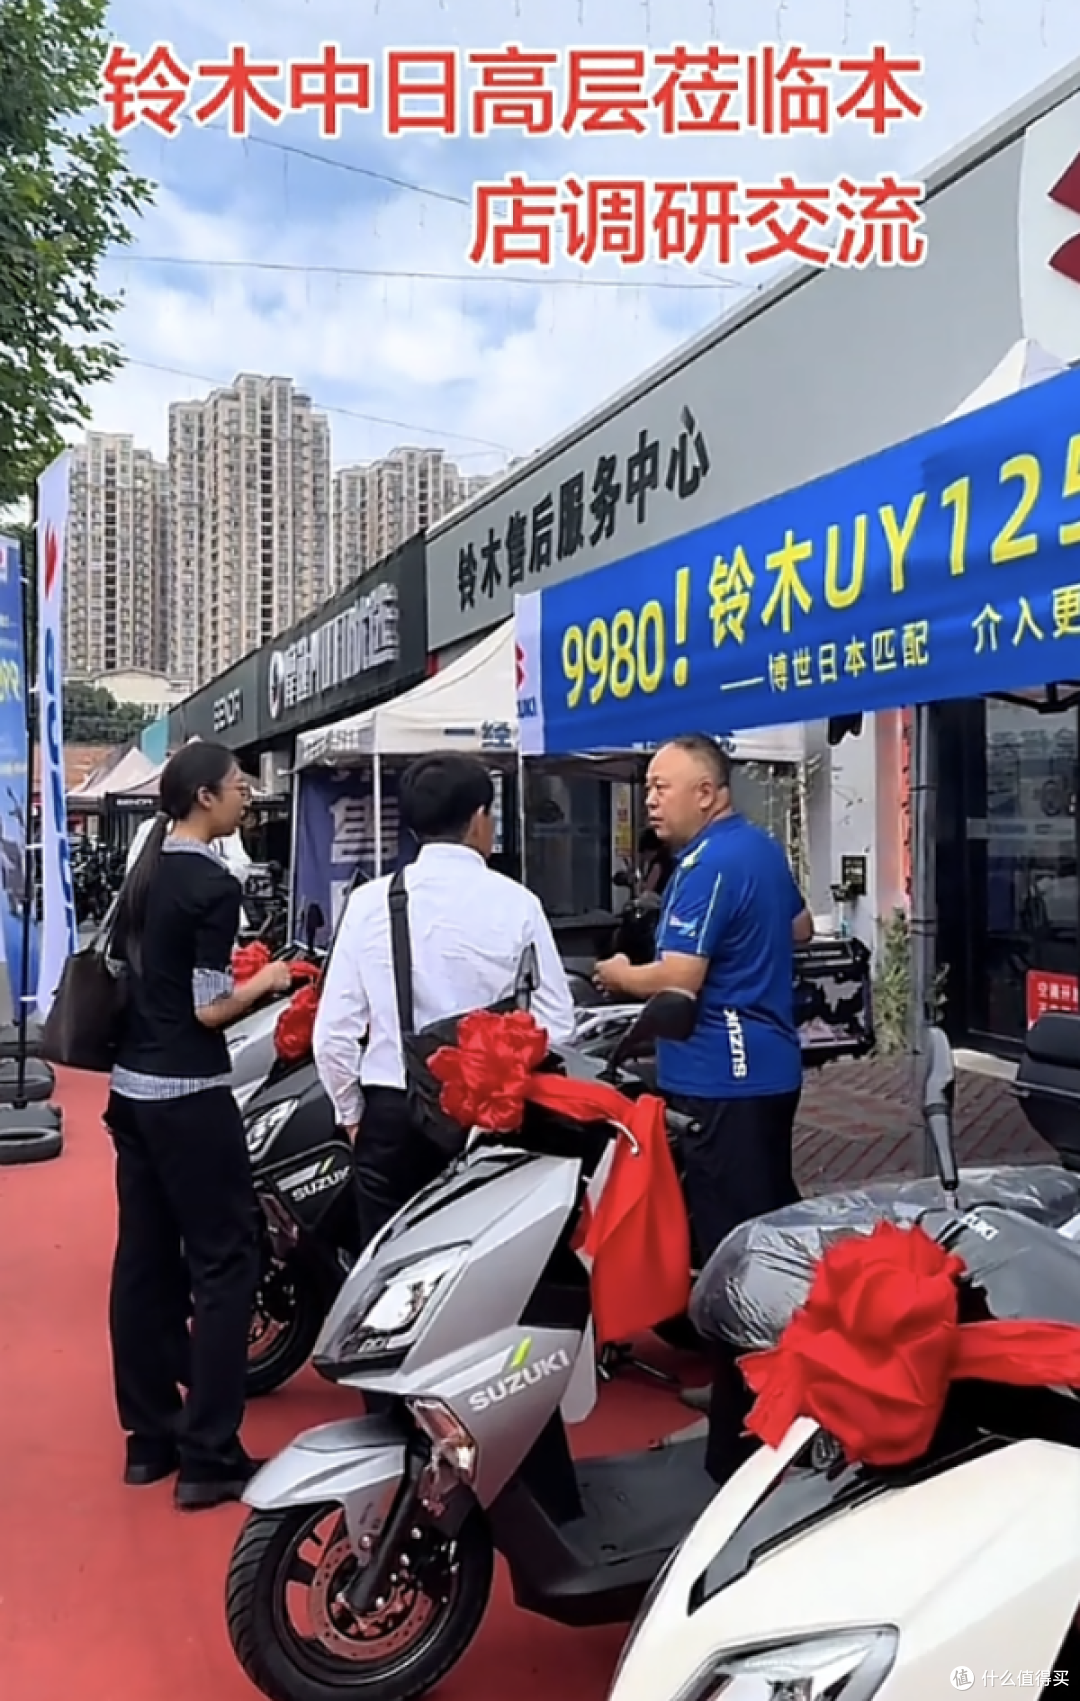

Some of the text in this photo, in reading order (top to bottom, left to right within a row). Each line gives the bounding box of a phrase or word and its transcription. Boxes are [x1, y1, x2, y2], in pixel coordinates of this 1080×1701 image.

[457, 405, 710, 612] 铃木售后服务中心
[723, 1006, 748, 1079] SUZUK
[291, 1165, 351, 1202] SUZUK
[468, 1350, 571, 1412] SUZUKI
